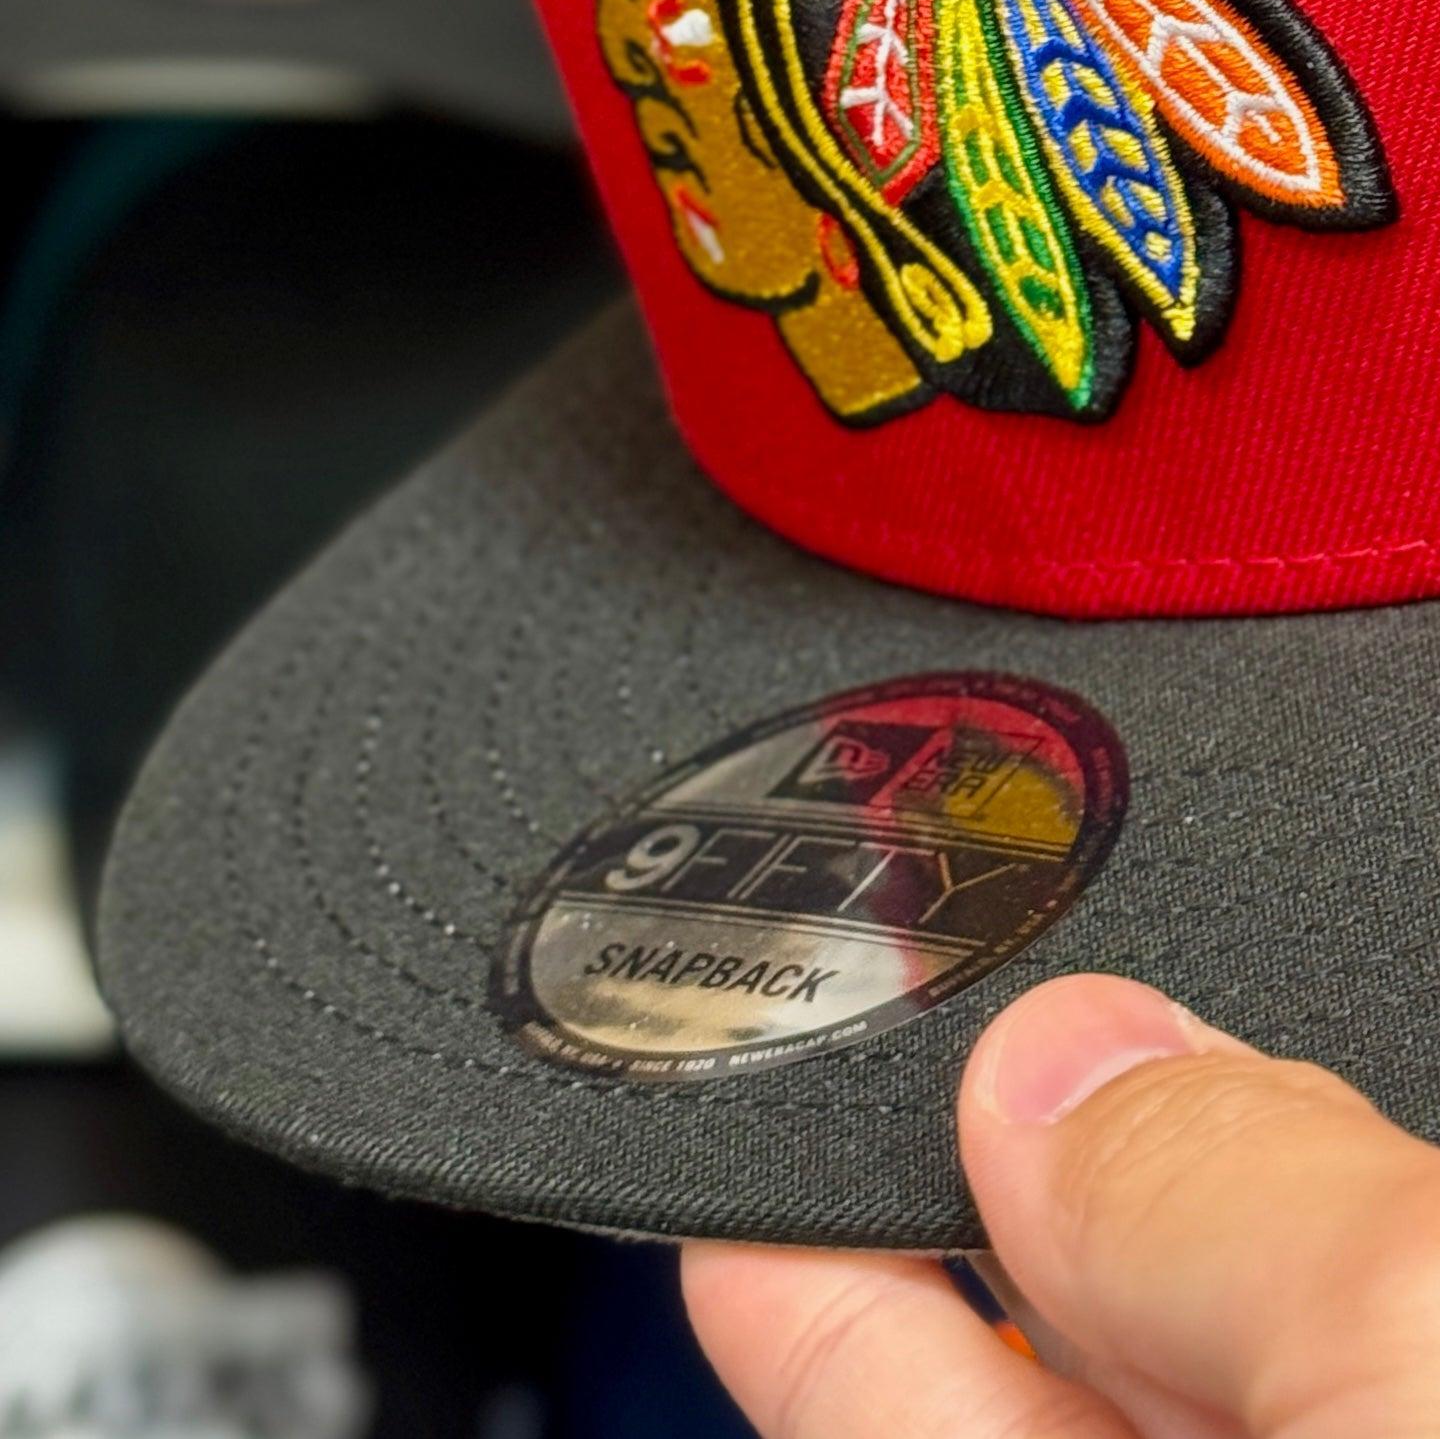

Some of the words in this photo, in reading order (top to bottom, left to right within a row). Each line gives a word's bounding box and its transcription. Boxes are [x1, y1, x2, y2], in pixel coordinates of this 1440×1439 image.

[902, 767, 988, 799] ERA
[922, 746, 1012, 774] NEW
[604, 824, 1018, 925] 9FIFTY
[583, 942, 838, 1003] SNAPBACK
